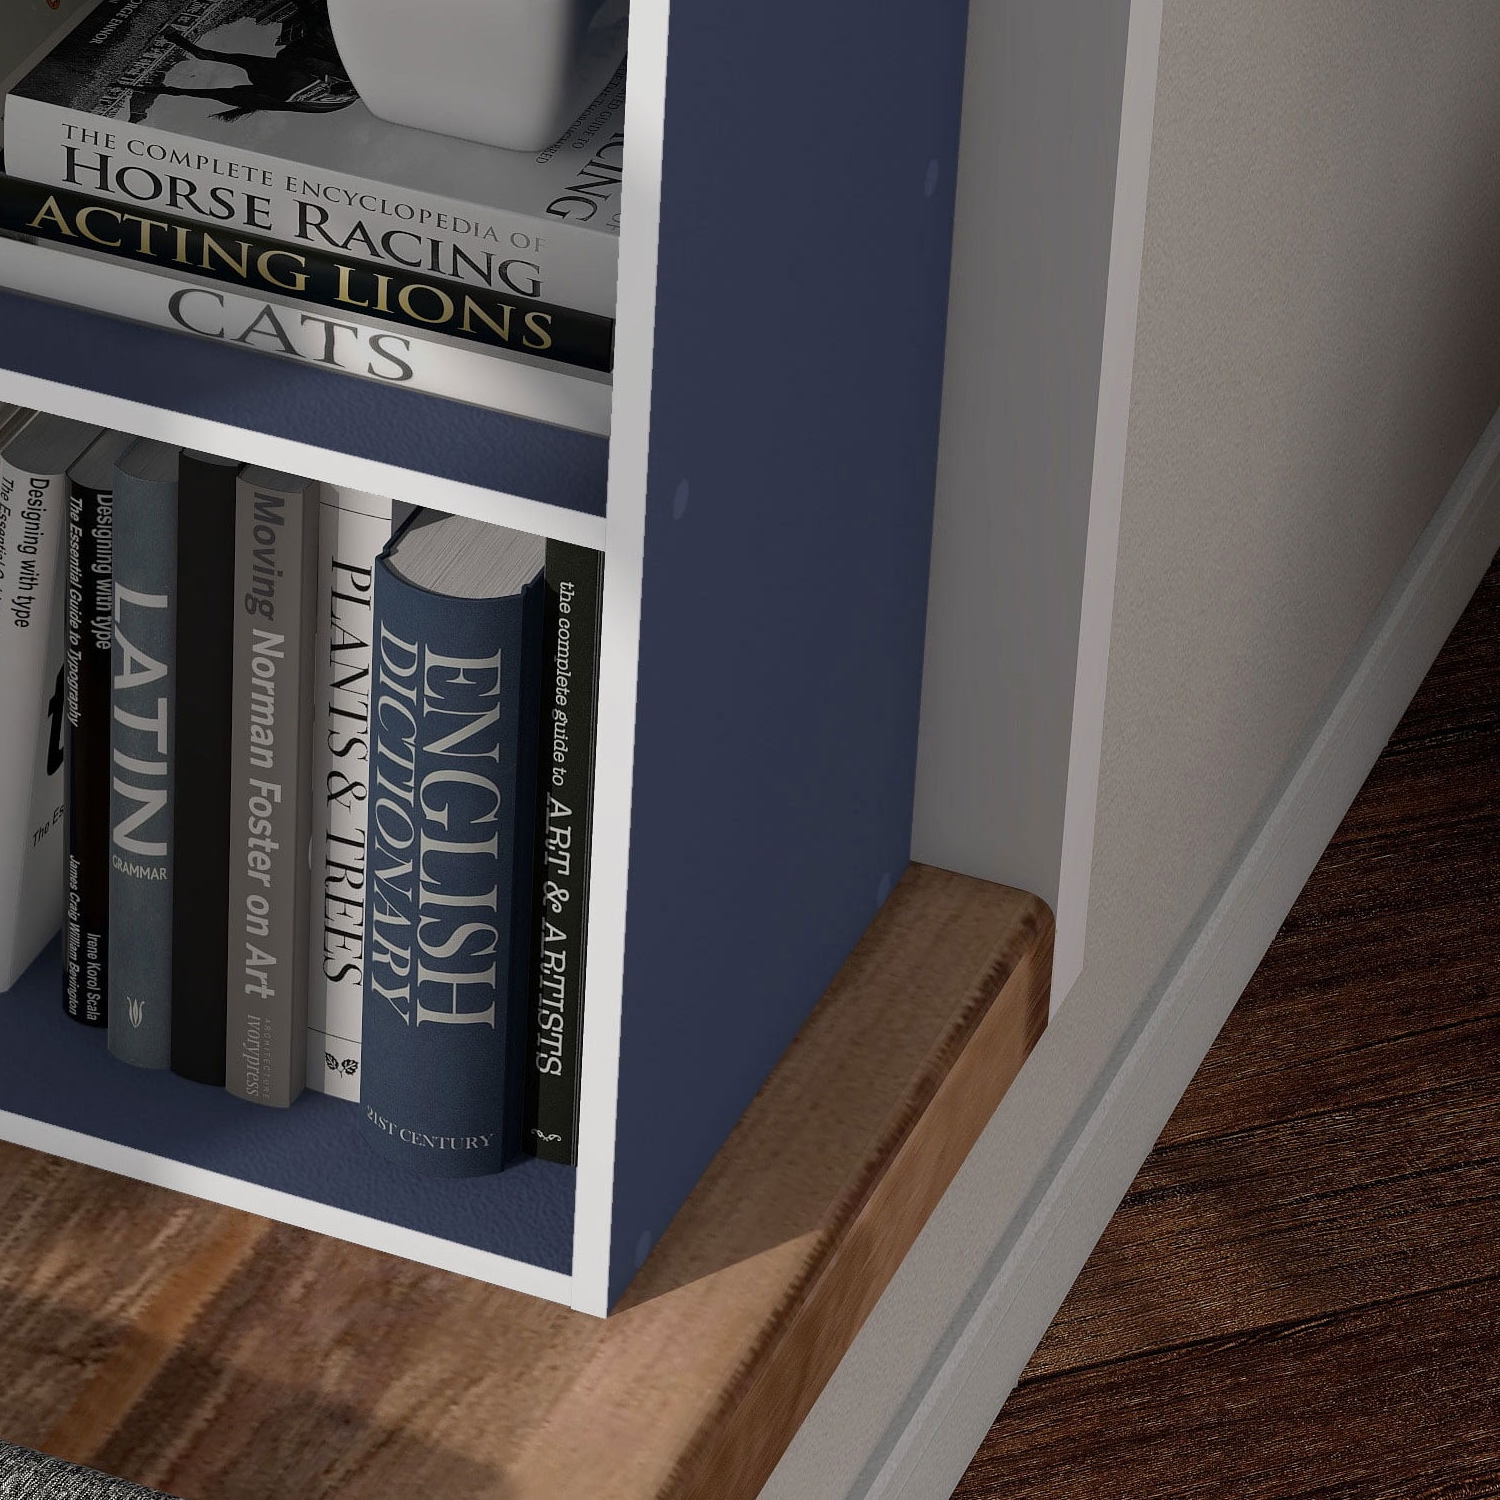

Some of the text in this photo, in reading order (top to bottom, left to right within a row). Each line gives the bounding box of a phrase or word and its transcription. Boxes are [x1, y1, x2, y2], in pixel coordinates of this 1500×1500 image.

[88, 17, 124, 45] ENNOR
[60, 144, 544, 298] HORSE RACING
[61, 123, 547, 253] THE COMPLETE ENCYCLOPEDIA OF
[26, 195, 553, 350] ACTING LIONS
[167, 288, 414, 383] CATS
[0, 476, 14, 501] The
[11, 476, 51, 628] Designing with type
[66, 496, 83, 728] The Essential Guide to Typography
[90, 493, 113, 650] Designing with type
[112, 581, 168, 857] LATIN
[244, 491, 286, 1000] Moving Norman Foster on Art
[322, 555, 373, 987] PLANTS & TREES
[32, 822, 51, 848] The
[69, 854, 81, 892] James
[111, 855, 168, 881] GRAMMAR
[371, 619, 420, 1027] DICTIONARY
[416, 643, 503, 1030] ENGLISH
[537, 581, 575, 1077] the complete guide to ART & ARTISTS
[67, 890, 81, 923] Craig
[68, 921, 81, 961] William
[86, 932, 101, 1021] Irene Korol Scala
[263, 1018, 271, 1101] ARCHITECTURE
[366, 1104, 494, 1151] 21ST CENTURY
